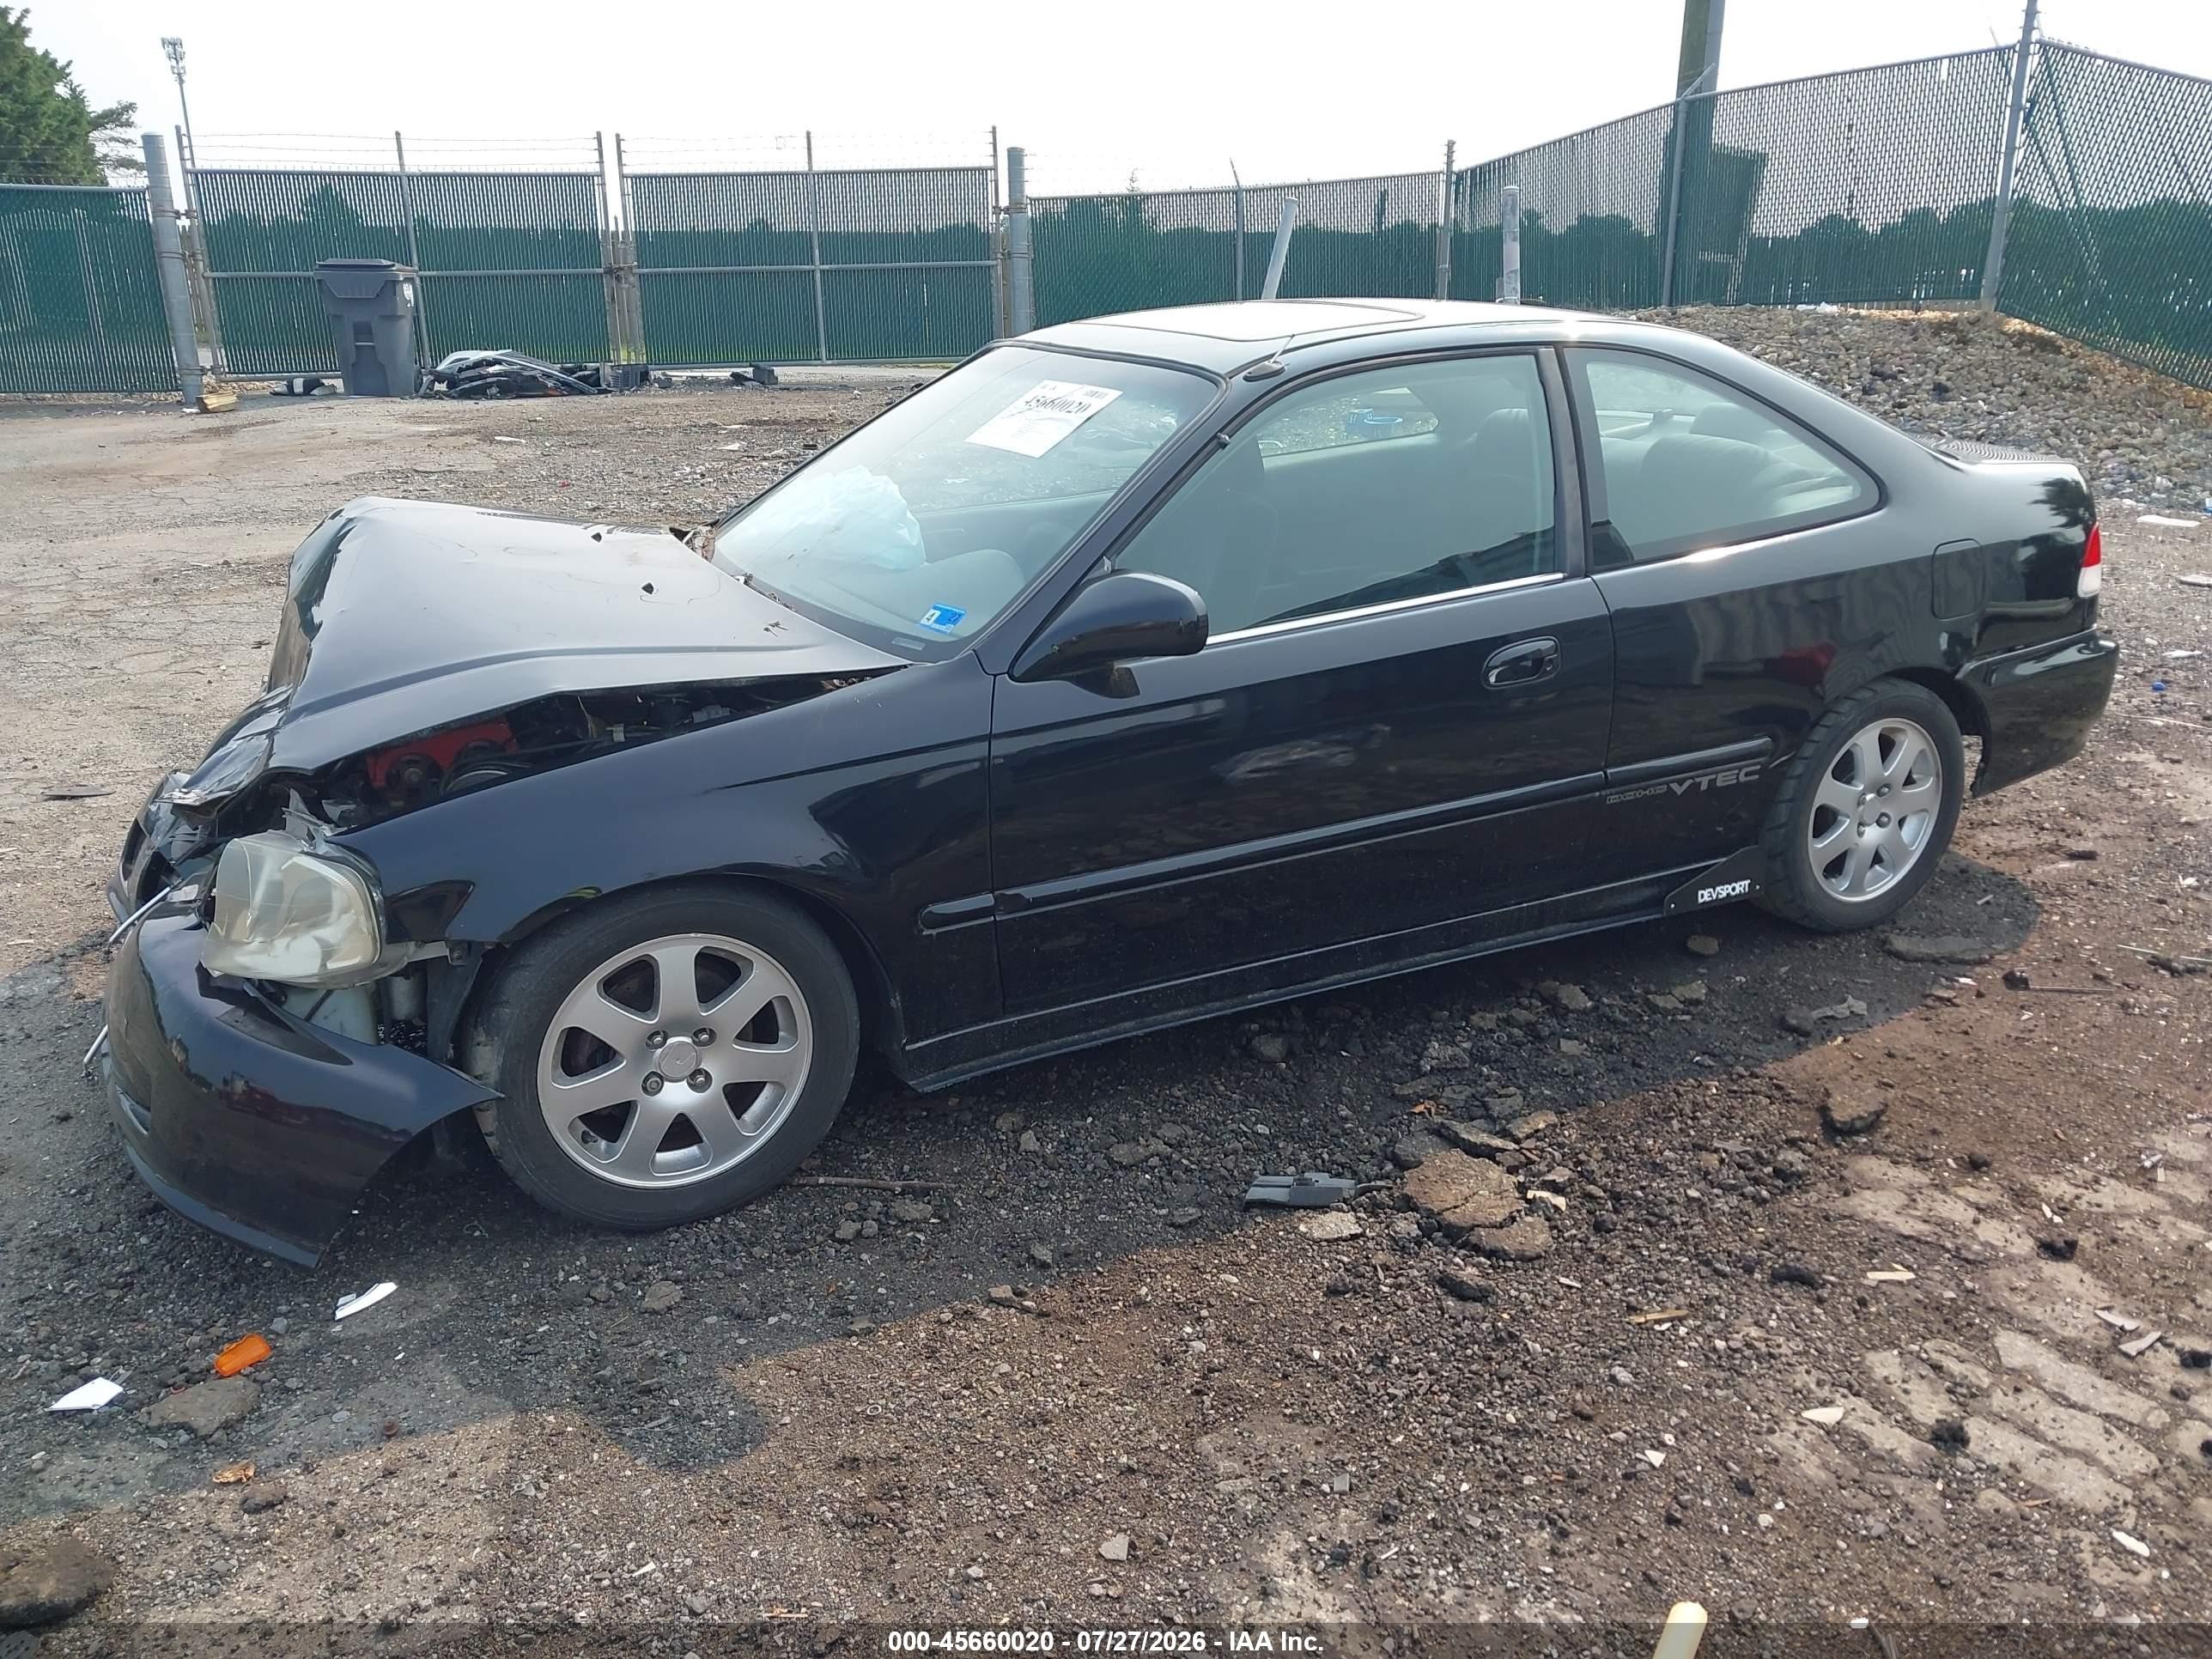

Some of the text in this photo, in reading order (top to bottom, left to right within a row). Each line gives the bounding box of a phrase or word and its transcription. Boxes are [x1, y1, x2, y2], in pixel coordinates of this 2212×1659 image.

[1025, 395, 1091, 414] 45660020
[1670, 765, 1761, 796] VTEC
[1698, 879, 1751, 903] DEVSPORT
